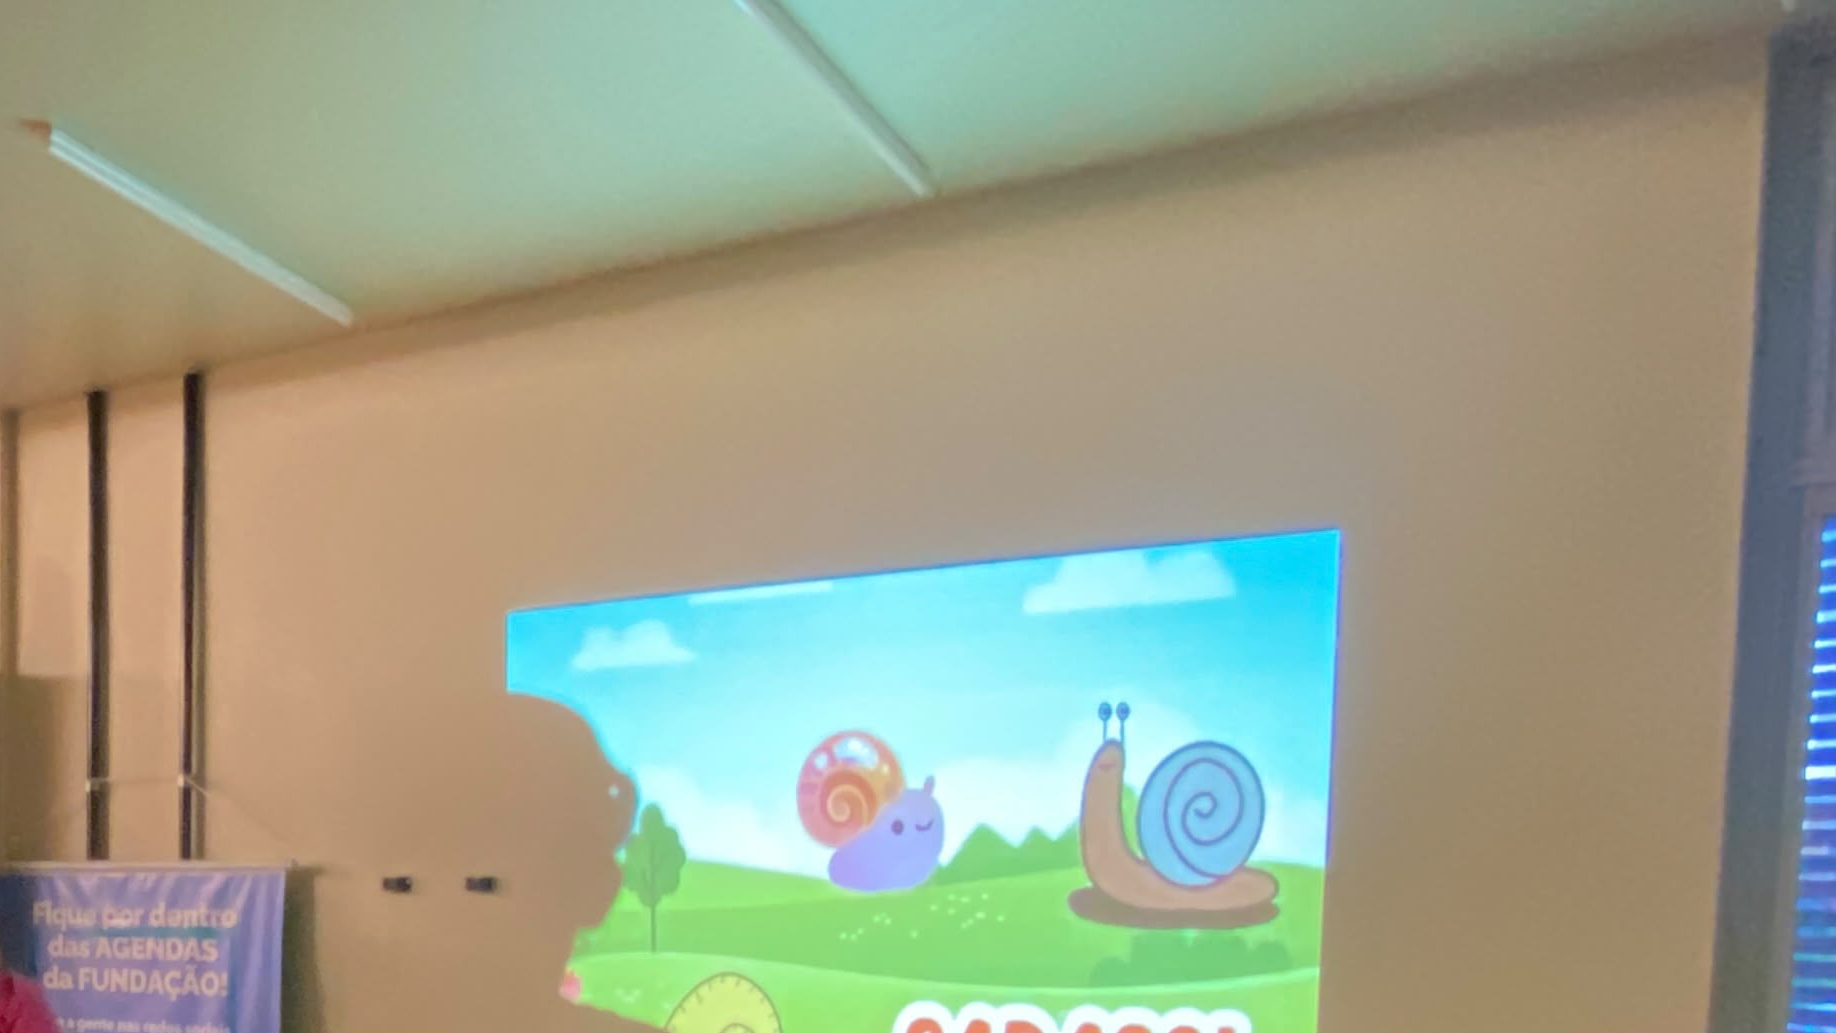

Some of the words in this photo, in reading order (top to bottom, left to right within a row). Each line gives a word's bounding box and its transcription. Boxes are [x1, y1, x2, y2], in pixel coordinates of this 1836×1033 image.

[32, 902, 96, 930] Fique
[102, 905, 144, 930] por
[149, 902, 238, 929] dentro
[48, 935, 90, 959] das
[95, 937, 219, 962] AGENDAS
[43, 966, 74, 990] da
[78, 966, 229, 1001] FUNDAÇÃO!
[77, 1018, 115, 1033] gente
[117, 1020, 140, 1033] nas
